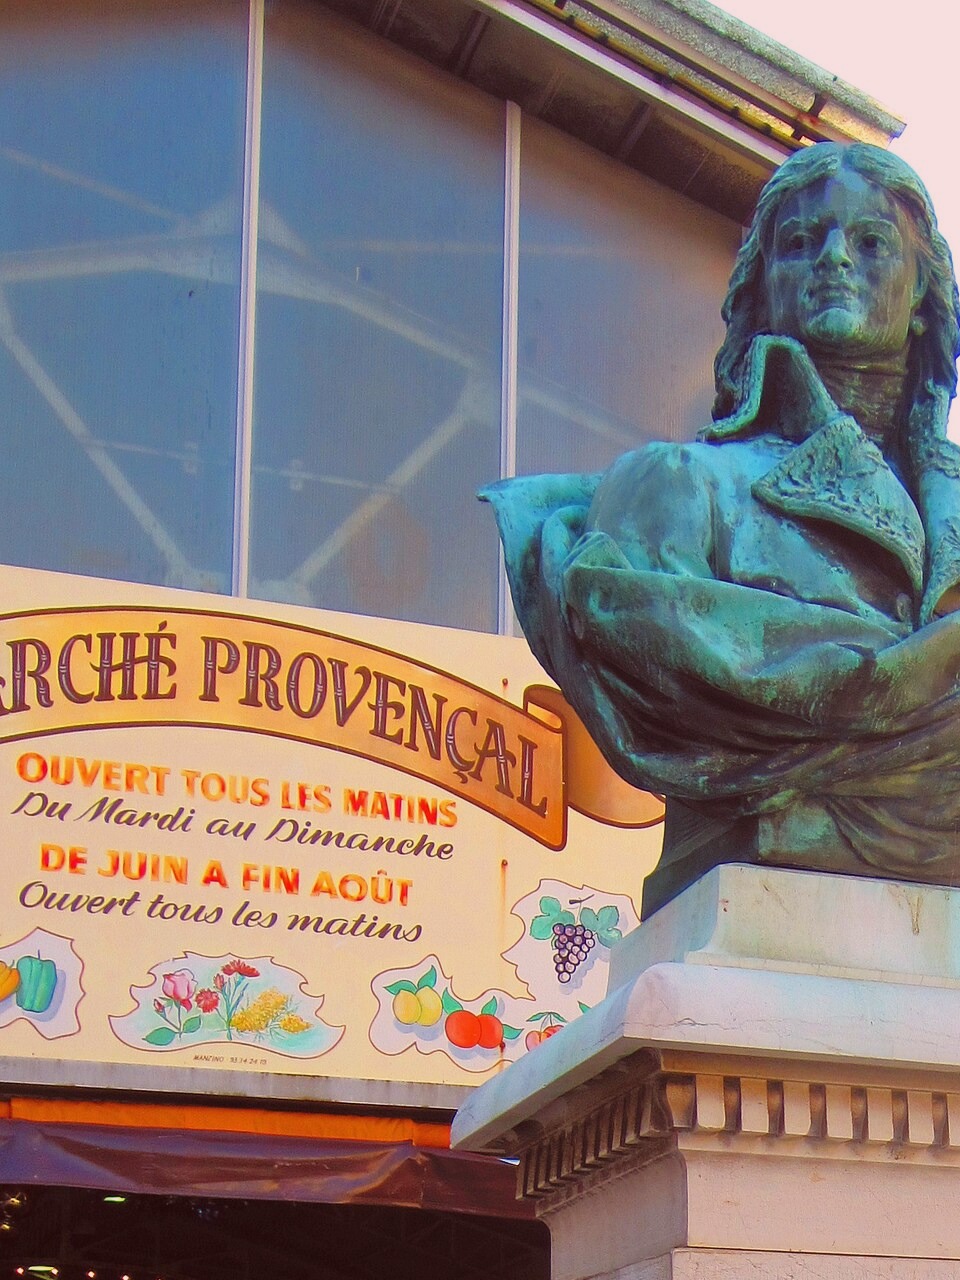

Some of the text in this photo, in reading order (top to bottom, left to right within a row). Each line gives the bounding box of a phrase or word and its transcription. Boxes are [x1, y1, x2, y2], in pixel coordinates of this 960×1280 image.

[0, 621, 548, 819] RCHÉ PROVENÇAL
[16, 752, 458, 827] OUVERT TOUS LES MATINS
[10, 791, 454, 860] Du Mardi au Dimanche
[40, 844, 413, 906] DE JUIN A FIN AOÛT
[19, 881, 423, 942] Ouvert tous les matins
